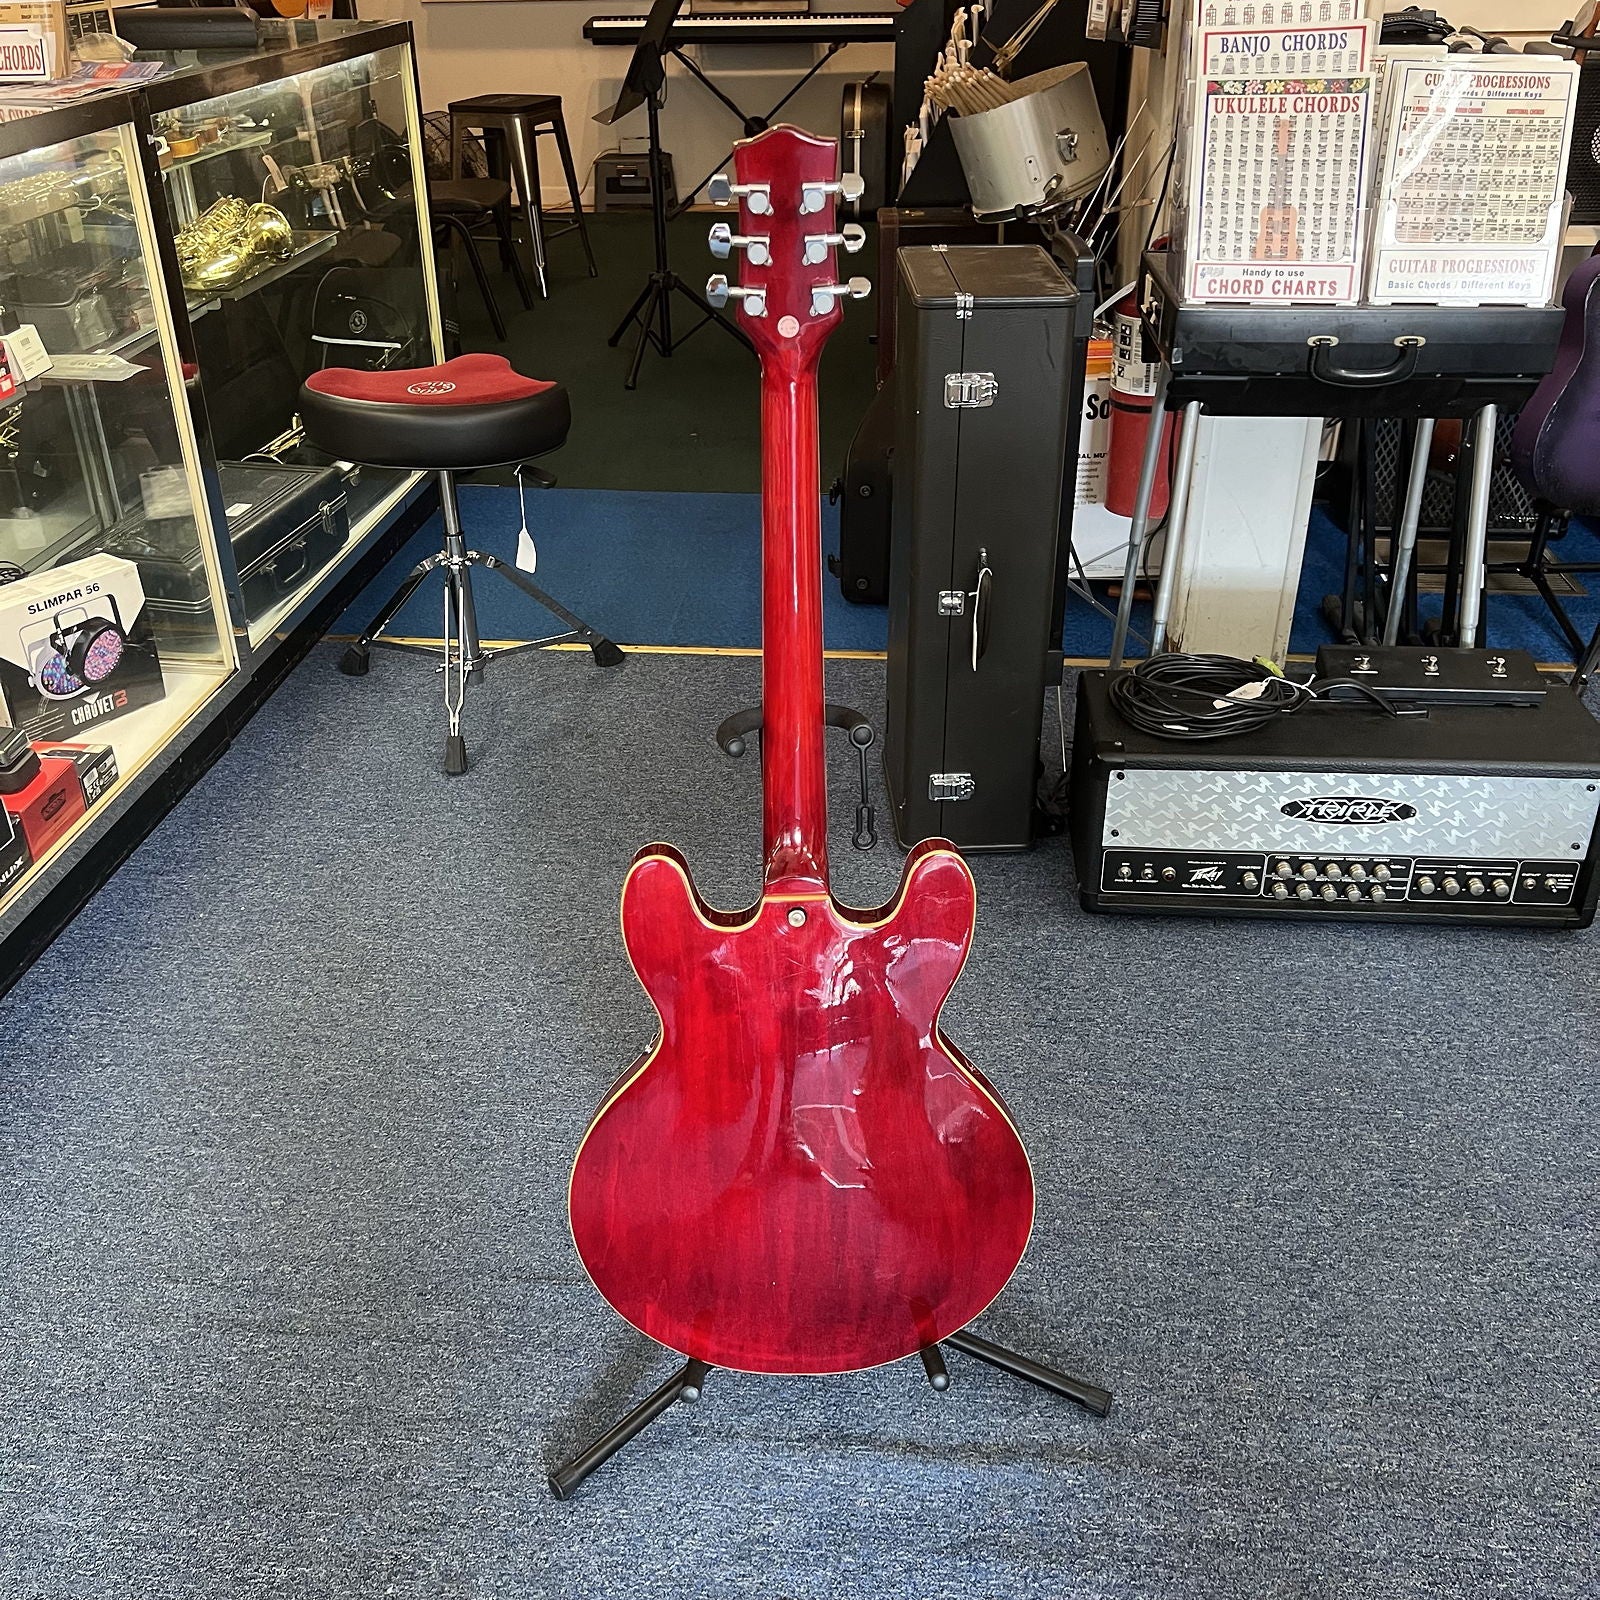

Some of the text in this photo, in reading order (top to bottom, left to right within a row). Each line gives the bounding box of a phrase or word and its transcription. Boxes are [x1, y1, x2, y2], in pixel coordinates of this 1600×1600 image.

[1220, 32, 1348, 57] BANJO CHORDS
[1524, 91, 1543, 99] Keys
[1214, 95, 1360, 114] UKULELE CHORDS
[1242, 268, 1272, 278] Handy
[1389, 259, 1536, 274] GUITAR PROGRESSIONS
[1207, 278, 1337, 296] CHORD CHARTS
[1388, 280, 1414, 289] Basic
[1418, 281, 1451, 289] Chords
[1461, 281, 1504, 289] Different
[1508, 282, 1532, 290] Keys
[27, 582, 100, 615] SLIMPAR 56
[71, 693, 115, 726] CHAUVET
[1305, 803, 1396, 818] TRIPLE
